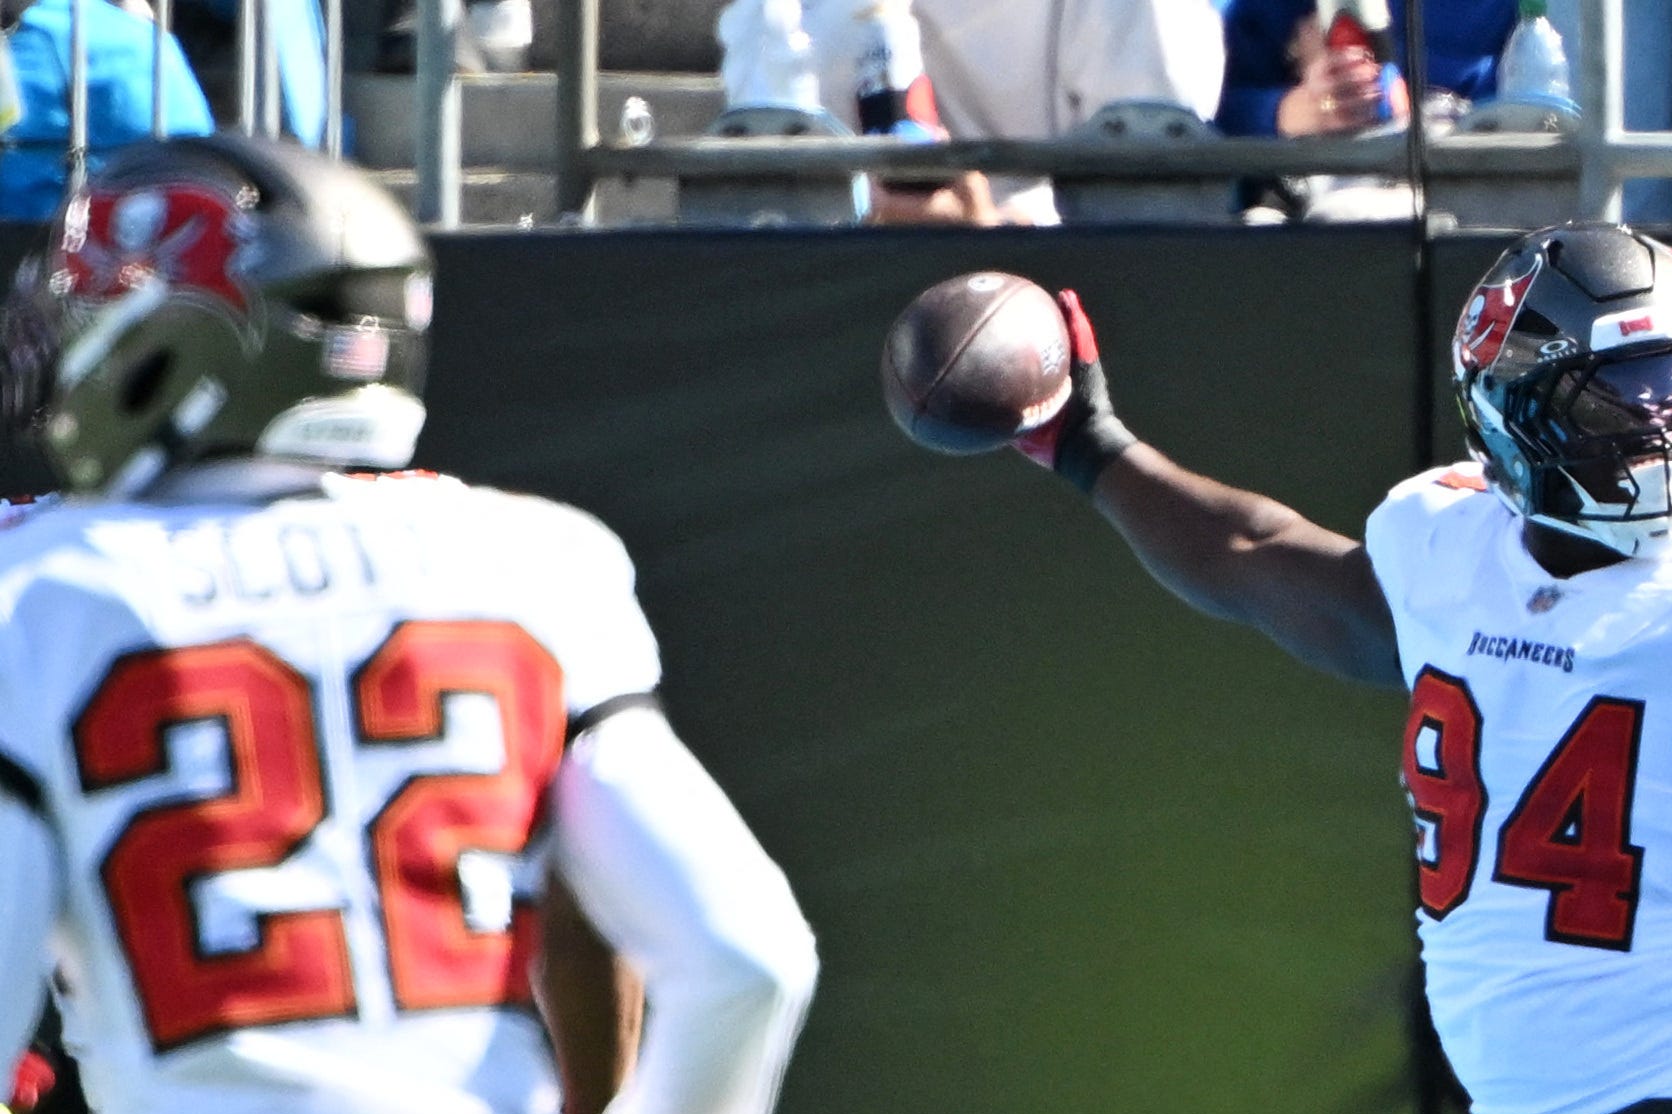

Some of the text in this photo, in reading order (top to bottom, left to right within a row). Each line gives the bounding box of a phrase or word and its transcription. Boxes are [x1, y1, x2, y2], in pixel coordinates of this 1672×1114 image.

[1466, 631, 1575, 673] BUCCANEERS
[70, 620, 568, 1055] 22
[1403, 663, 1646, 953] 94
